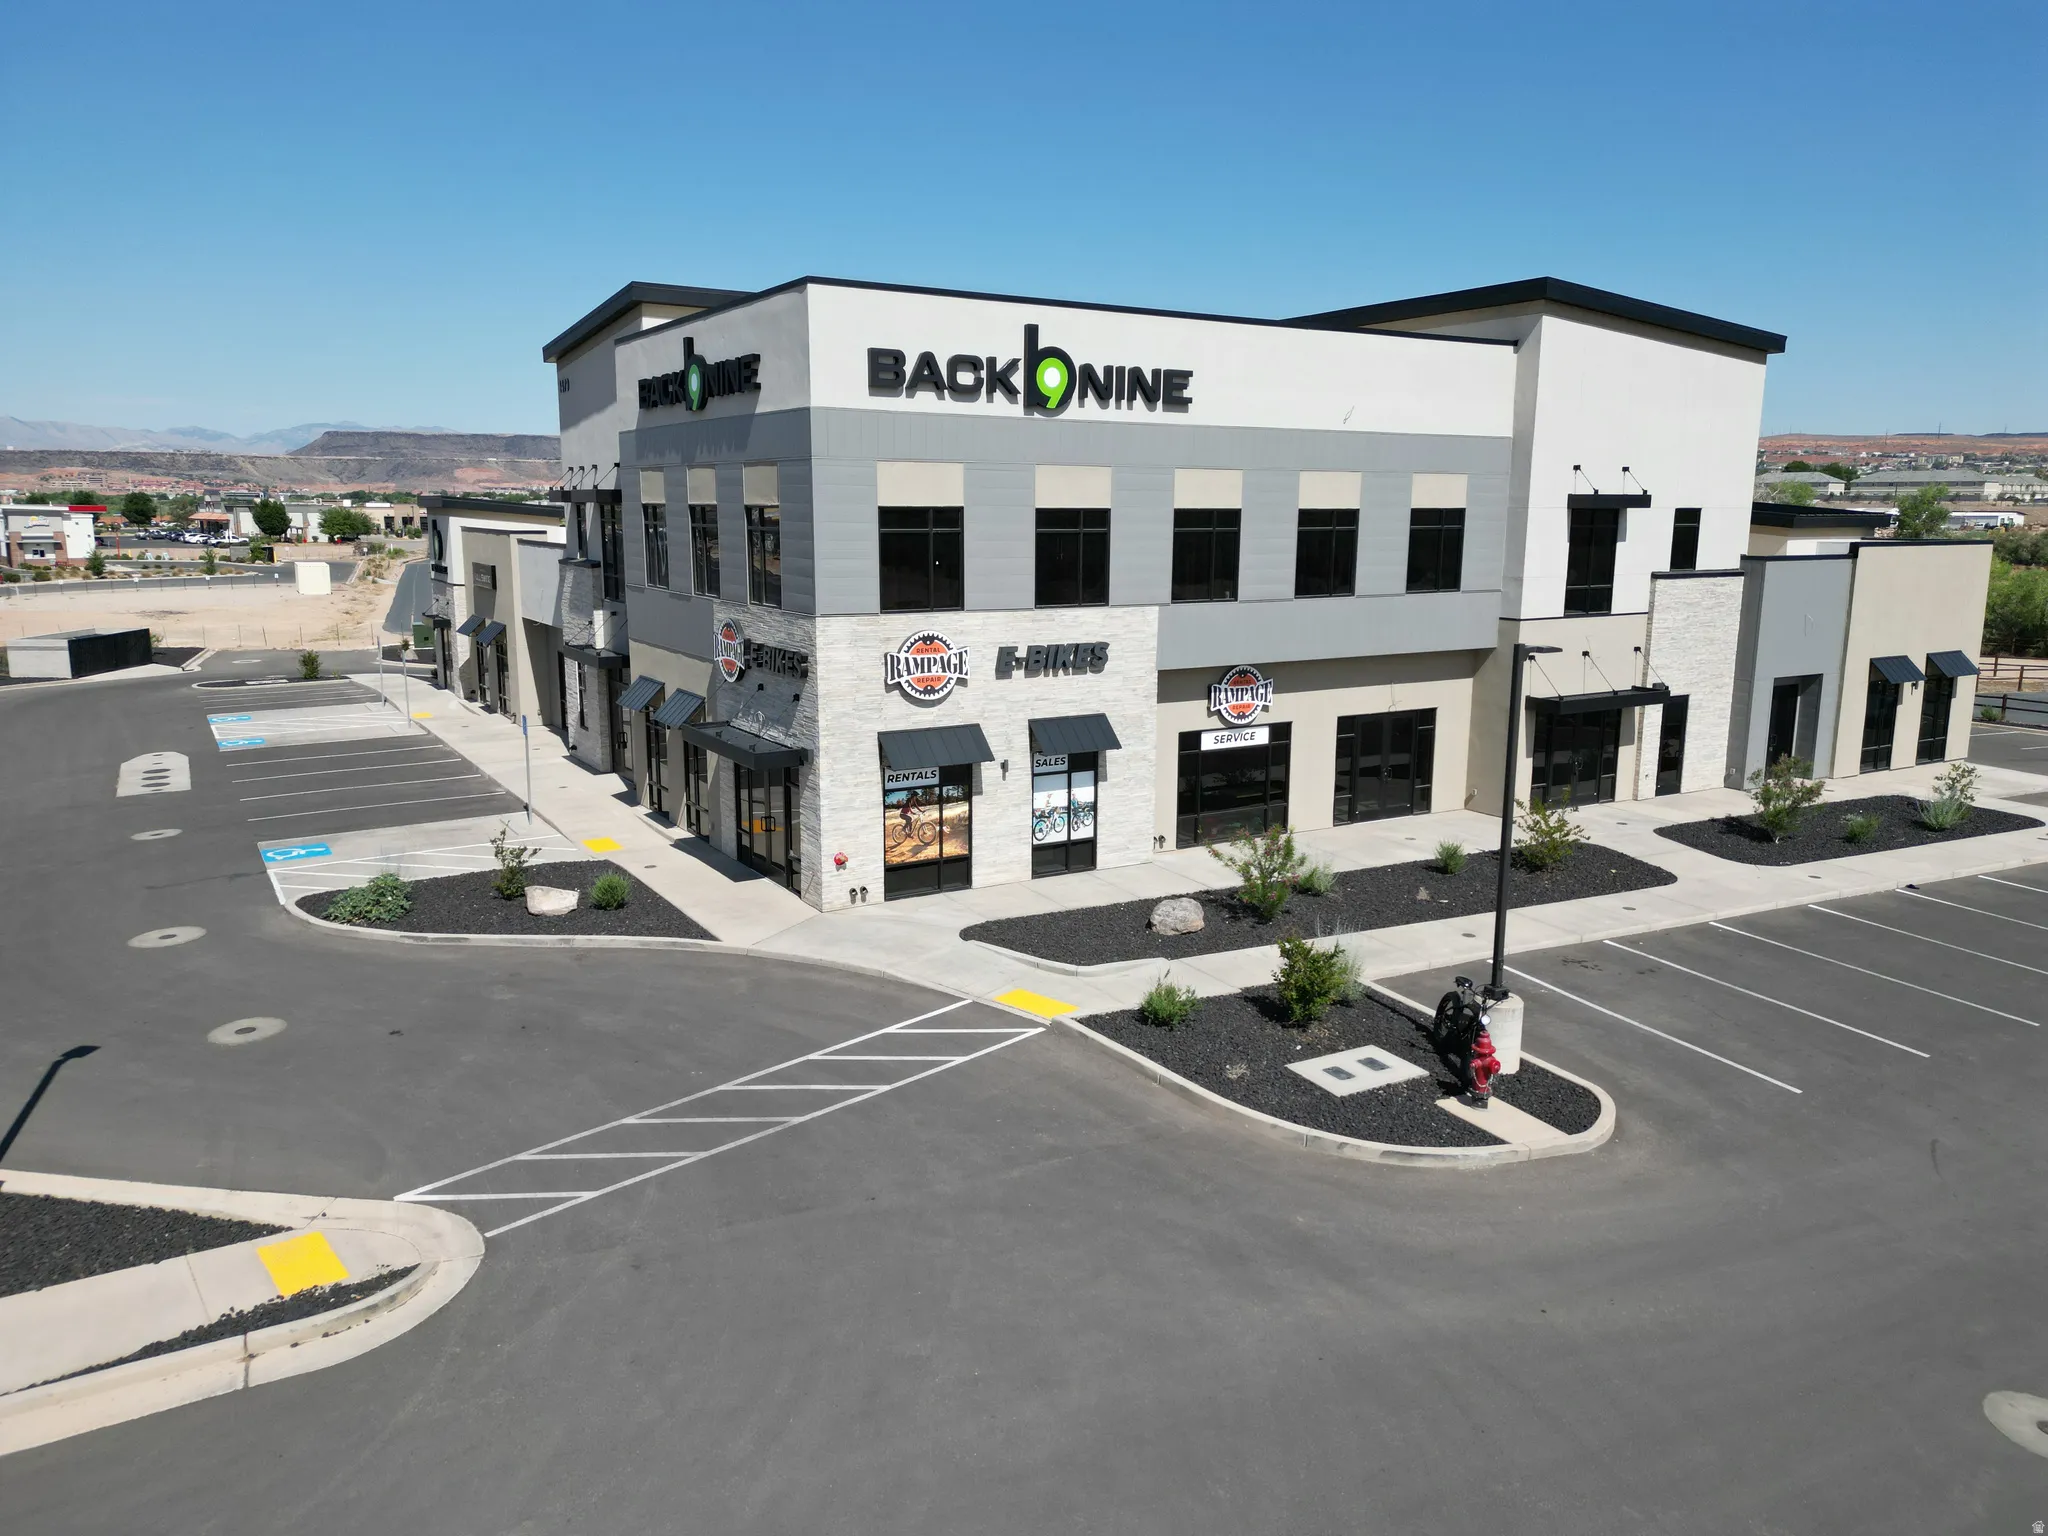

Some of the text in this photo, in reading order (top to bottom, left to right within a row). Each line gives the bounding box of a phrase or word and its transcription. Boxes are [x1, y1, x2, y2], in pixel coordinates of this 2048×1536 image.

[706, 353, 761, 398] NINE
[867, 347, 1021, 396] BACK
[1078, 362, 1194, 406] NINE
[888, 649, 969, 682] RAMPAGE
[996, 641, 1110, 673] E-BIKES
[1212, 681, 1273, 708] RAMPAGE
[1213, 731, 1256, 745] SERVICE
[886, 769, 937, 784] RENTALS
[1034, 756, 1067, 768] SALES
